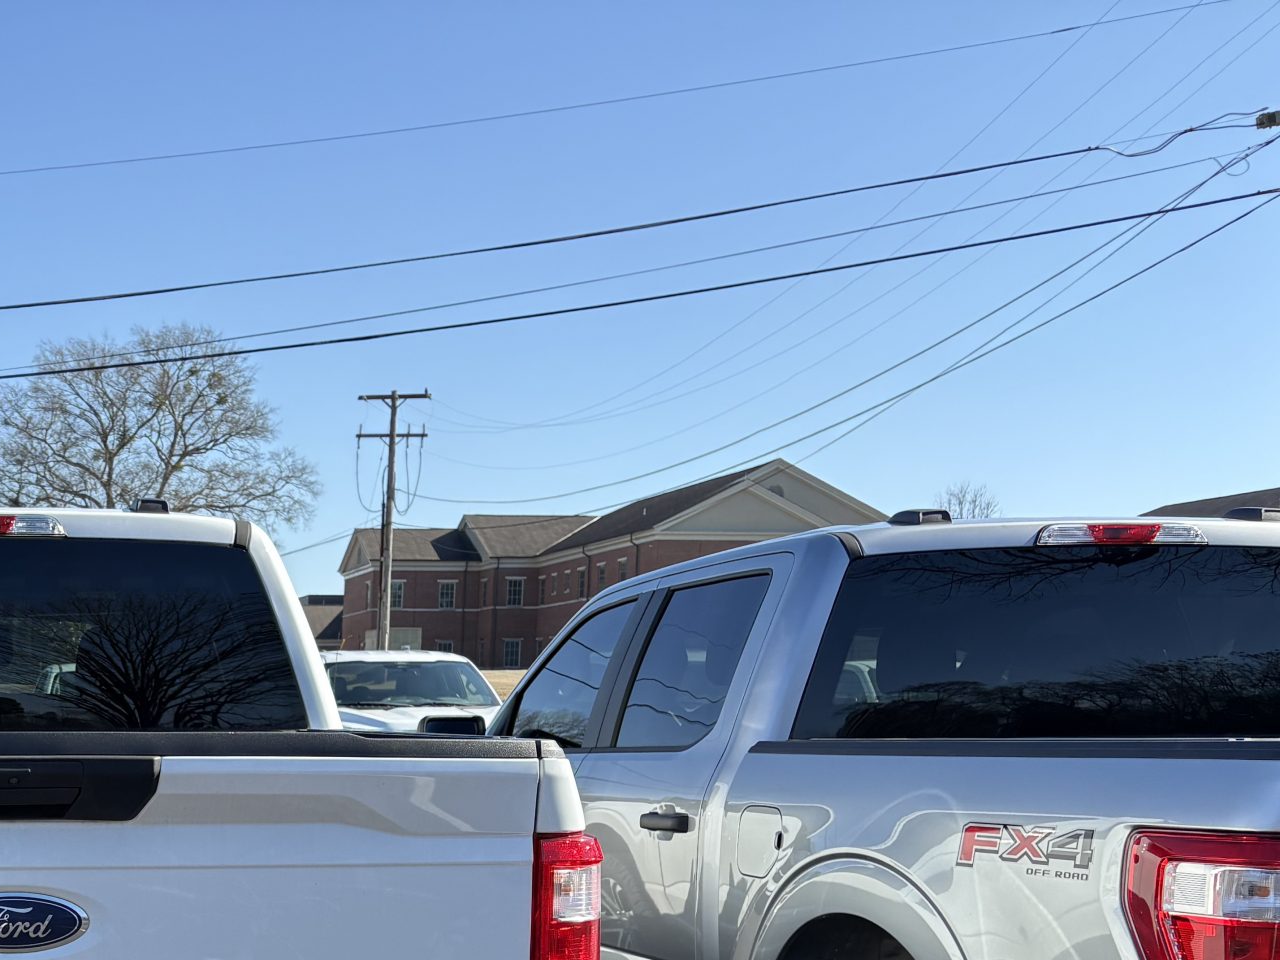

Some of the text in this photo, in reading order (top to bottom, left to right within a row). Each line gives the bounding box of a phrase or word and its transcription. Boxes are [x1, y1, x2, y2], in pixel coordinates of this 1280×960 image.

[956, 822, 1095, 869] FX4
[1026, 868, 1089, 881] OFF ROAD
